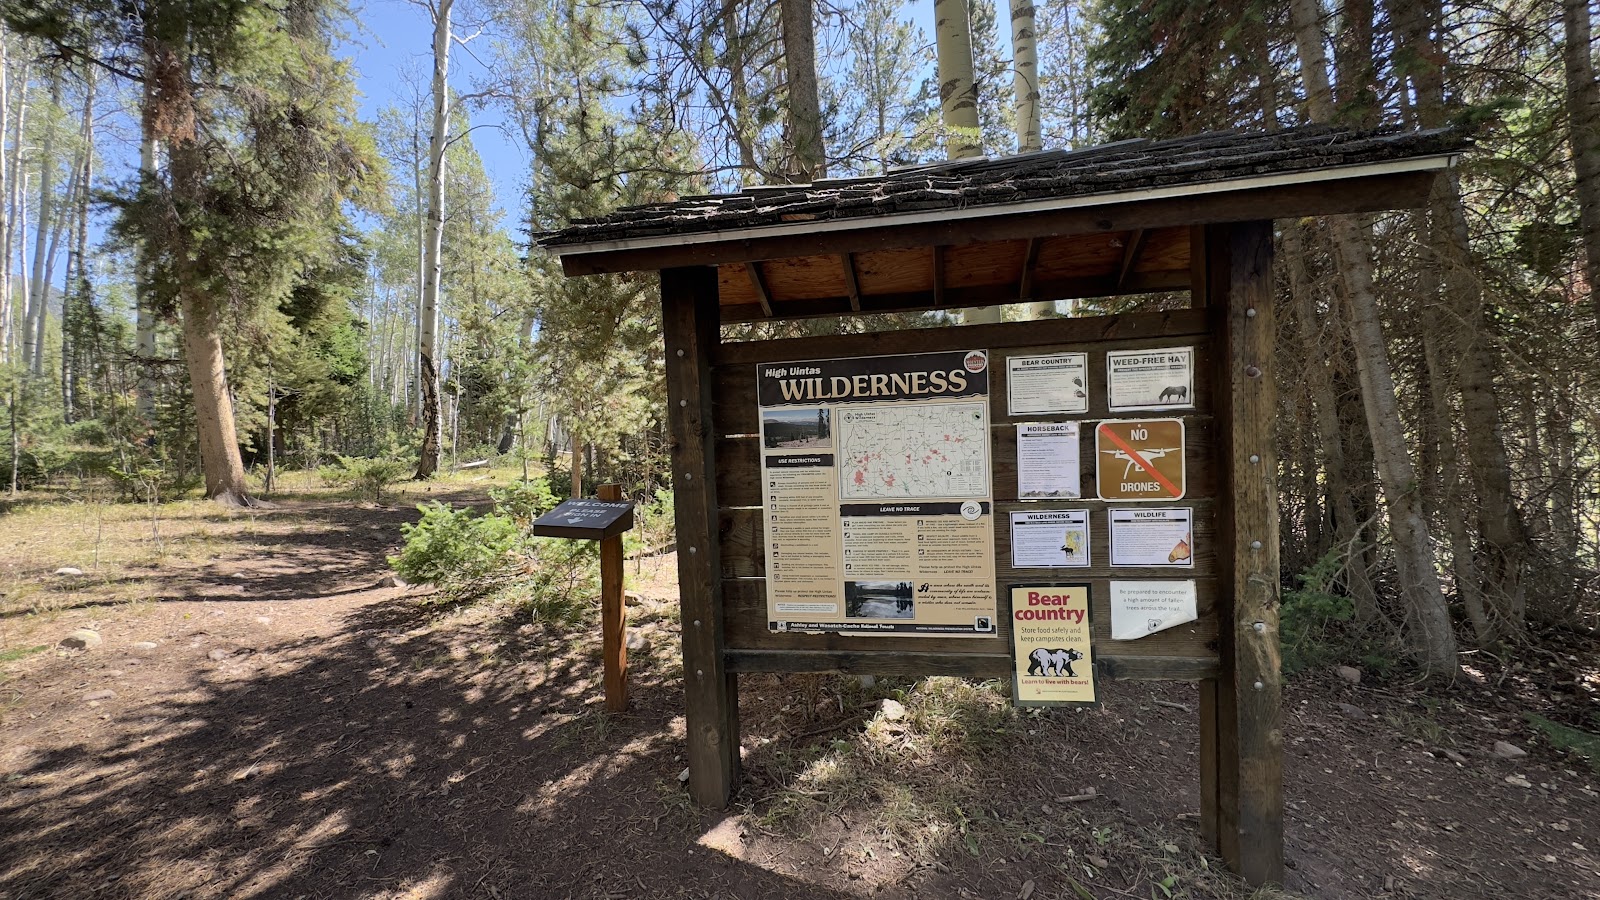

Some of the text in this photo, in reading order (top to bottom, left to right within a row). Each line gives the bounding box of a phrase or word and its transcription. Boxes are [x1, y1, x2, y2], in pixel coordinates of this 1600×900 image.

[1113, 356, 1166, 366] WEED-FREE
[765, 366, 821, 378] High Uintas
[779, 369, 968, 401] WILDERNESS
[1130, 428, 1148, 440] NO
[1120, 482, 1160, 492] DRONES
[1028, 591, 1070, 606] Bear
[1014, 607, 1085, 624] country
